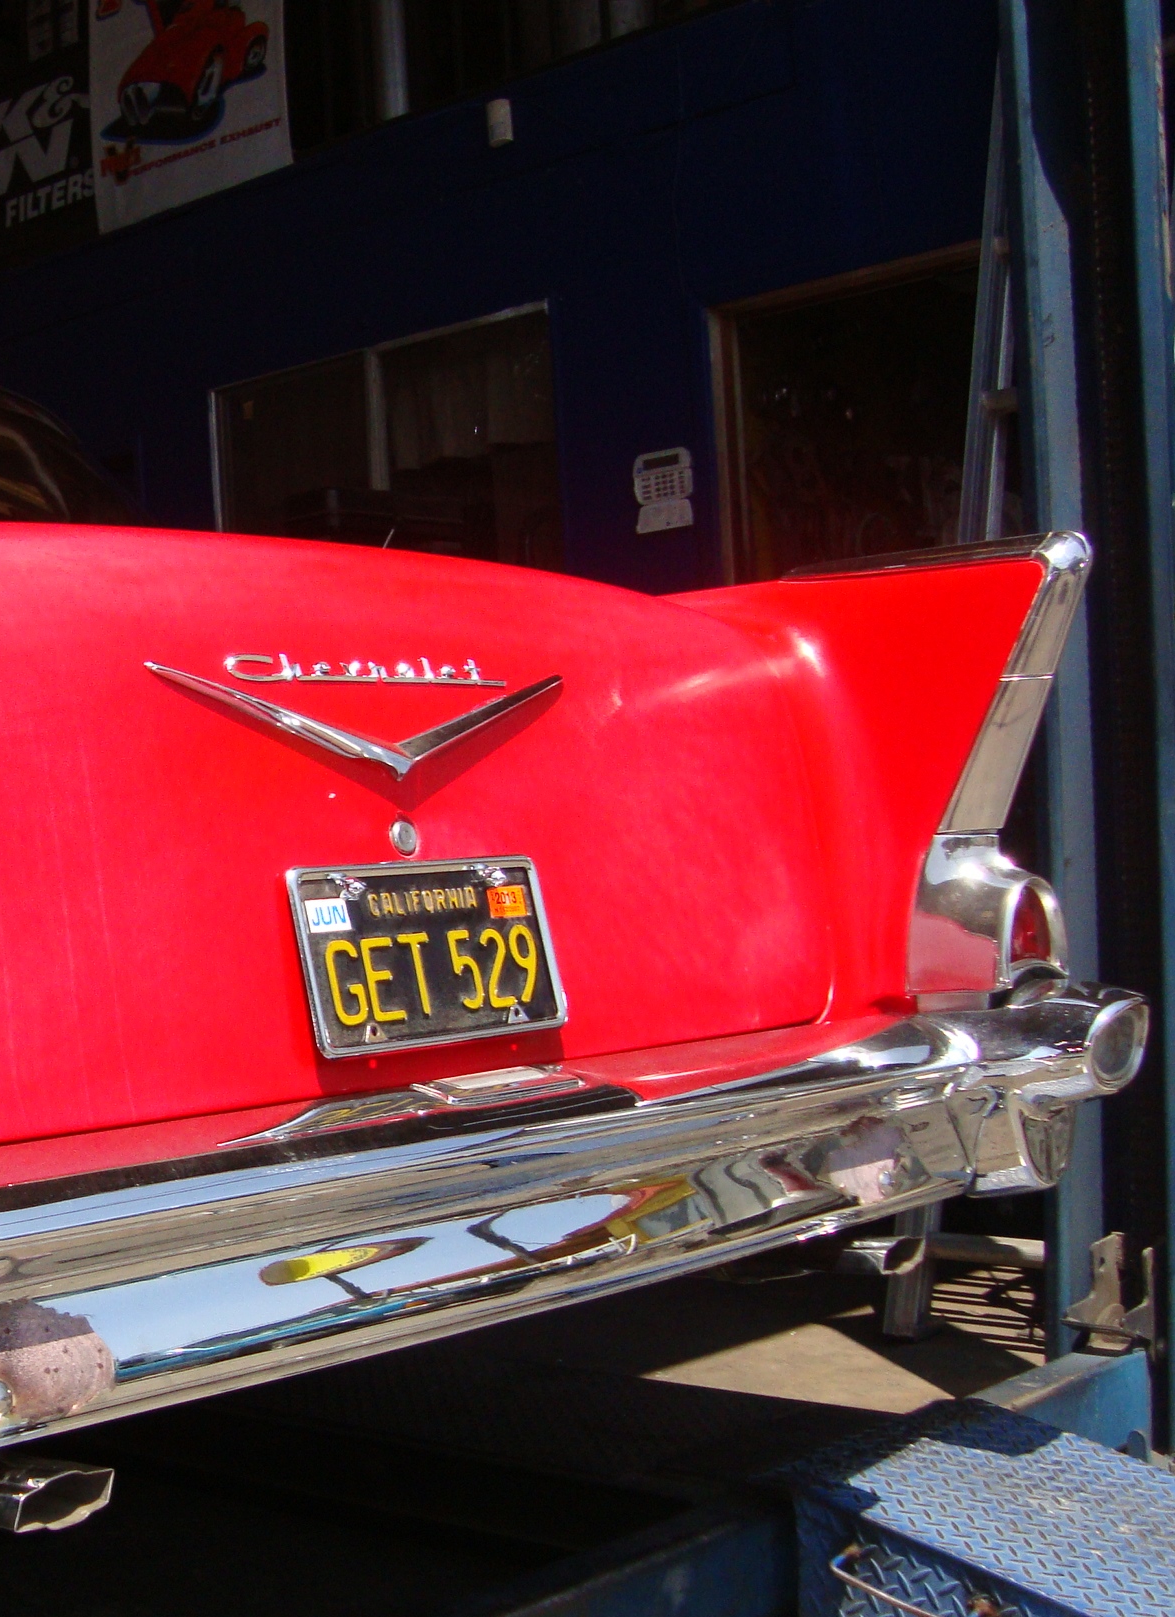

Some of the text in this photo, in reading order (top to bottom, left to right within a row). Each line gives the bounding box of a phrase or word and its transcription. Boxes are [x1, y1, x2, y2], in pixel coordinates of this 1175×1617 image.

[220, 116, 282, 145] EXHAUST
[5, 167, 96, 229] FILTERS
[368, 886, 478, 918] CALIFORNIA
[494, 890, 518, 905] 2013
[311, 904, 348, 927] JUN
[325, 924, 538, 1027] GET 529
